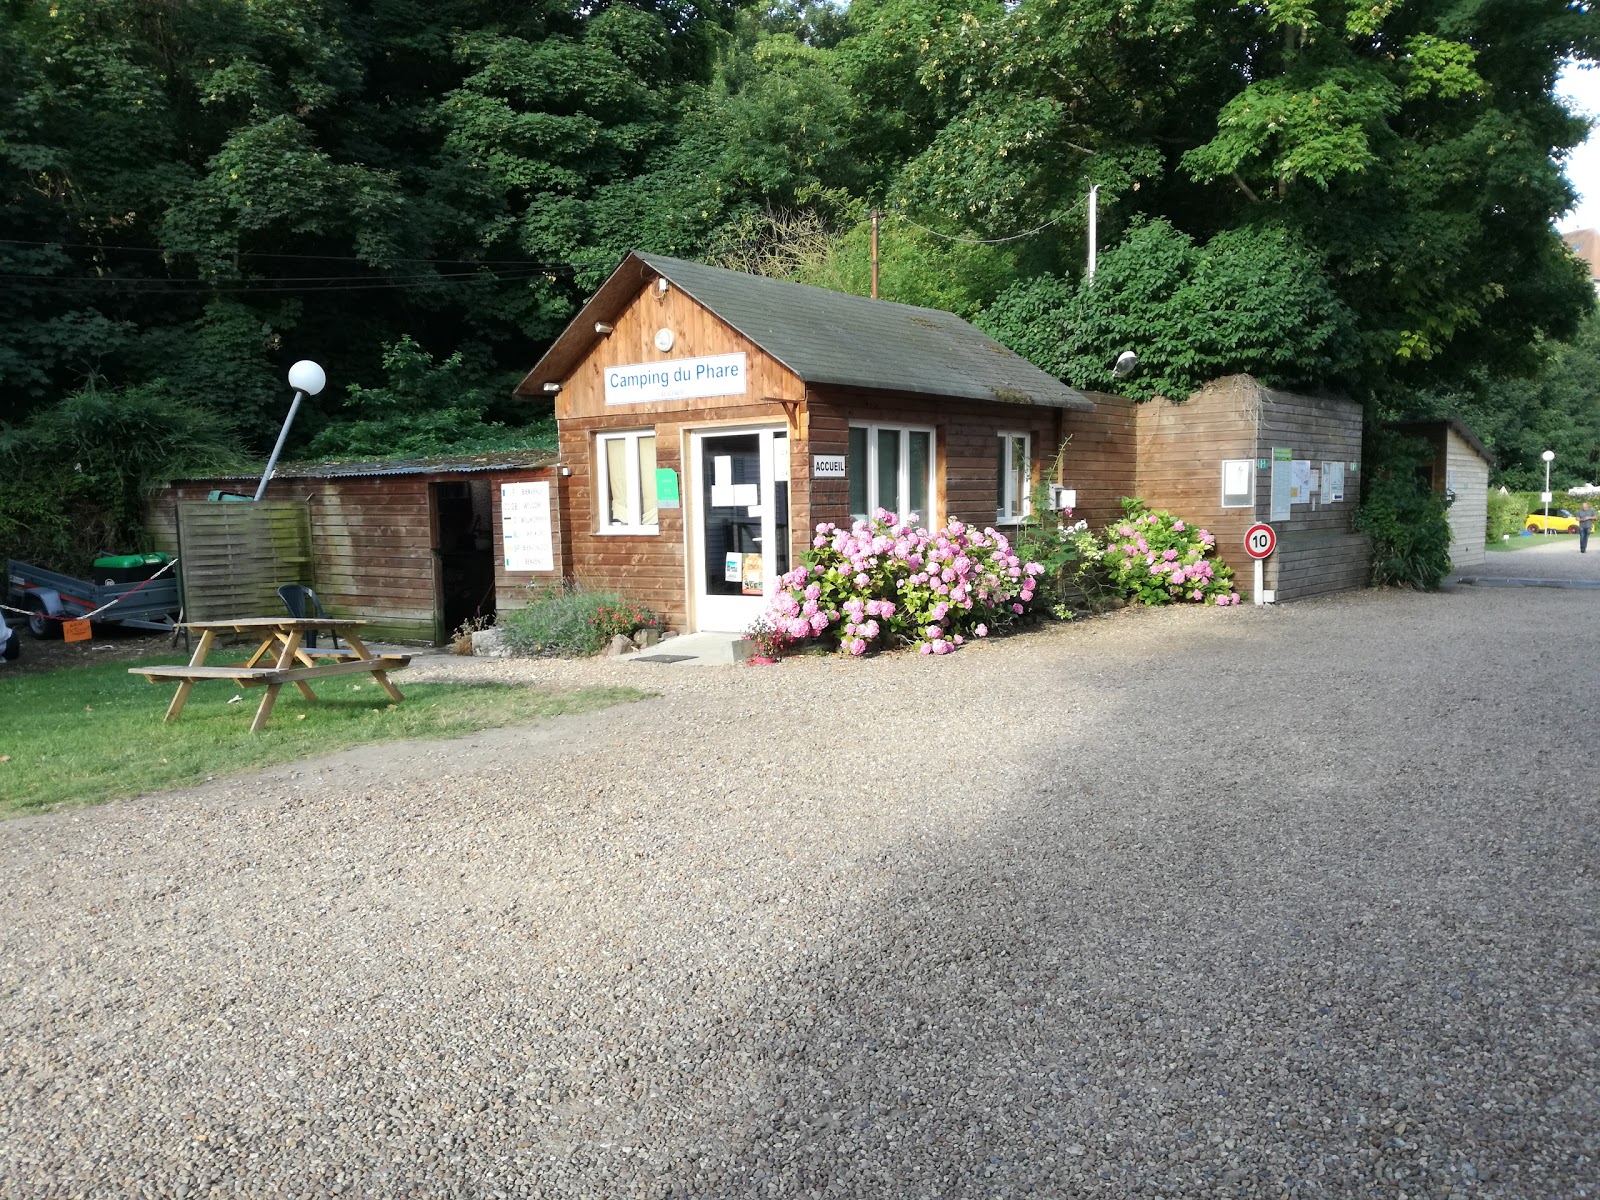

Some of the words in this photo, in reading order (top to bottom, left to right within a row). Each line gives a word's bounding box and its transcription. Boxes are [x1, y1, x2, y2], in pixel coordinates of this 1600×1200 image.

[610, 370, 669, 389] Camping
[673, 367, 691, 382] du
[696, 363, 739, 380] Phare
[815, 461, 845, 472] ACCUEIL
[1252, 534, 1268, 548] 10
